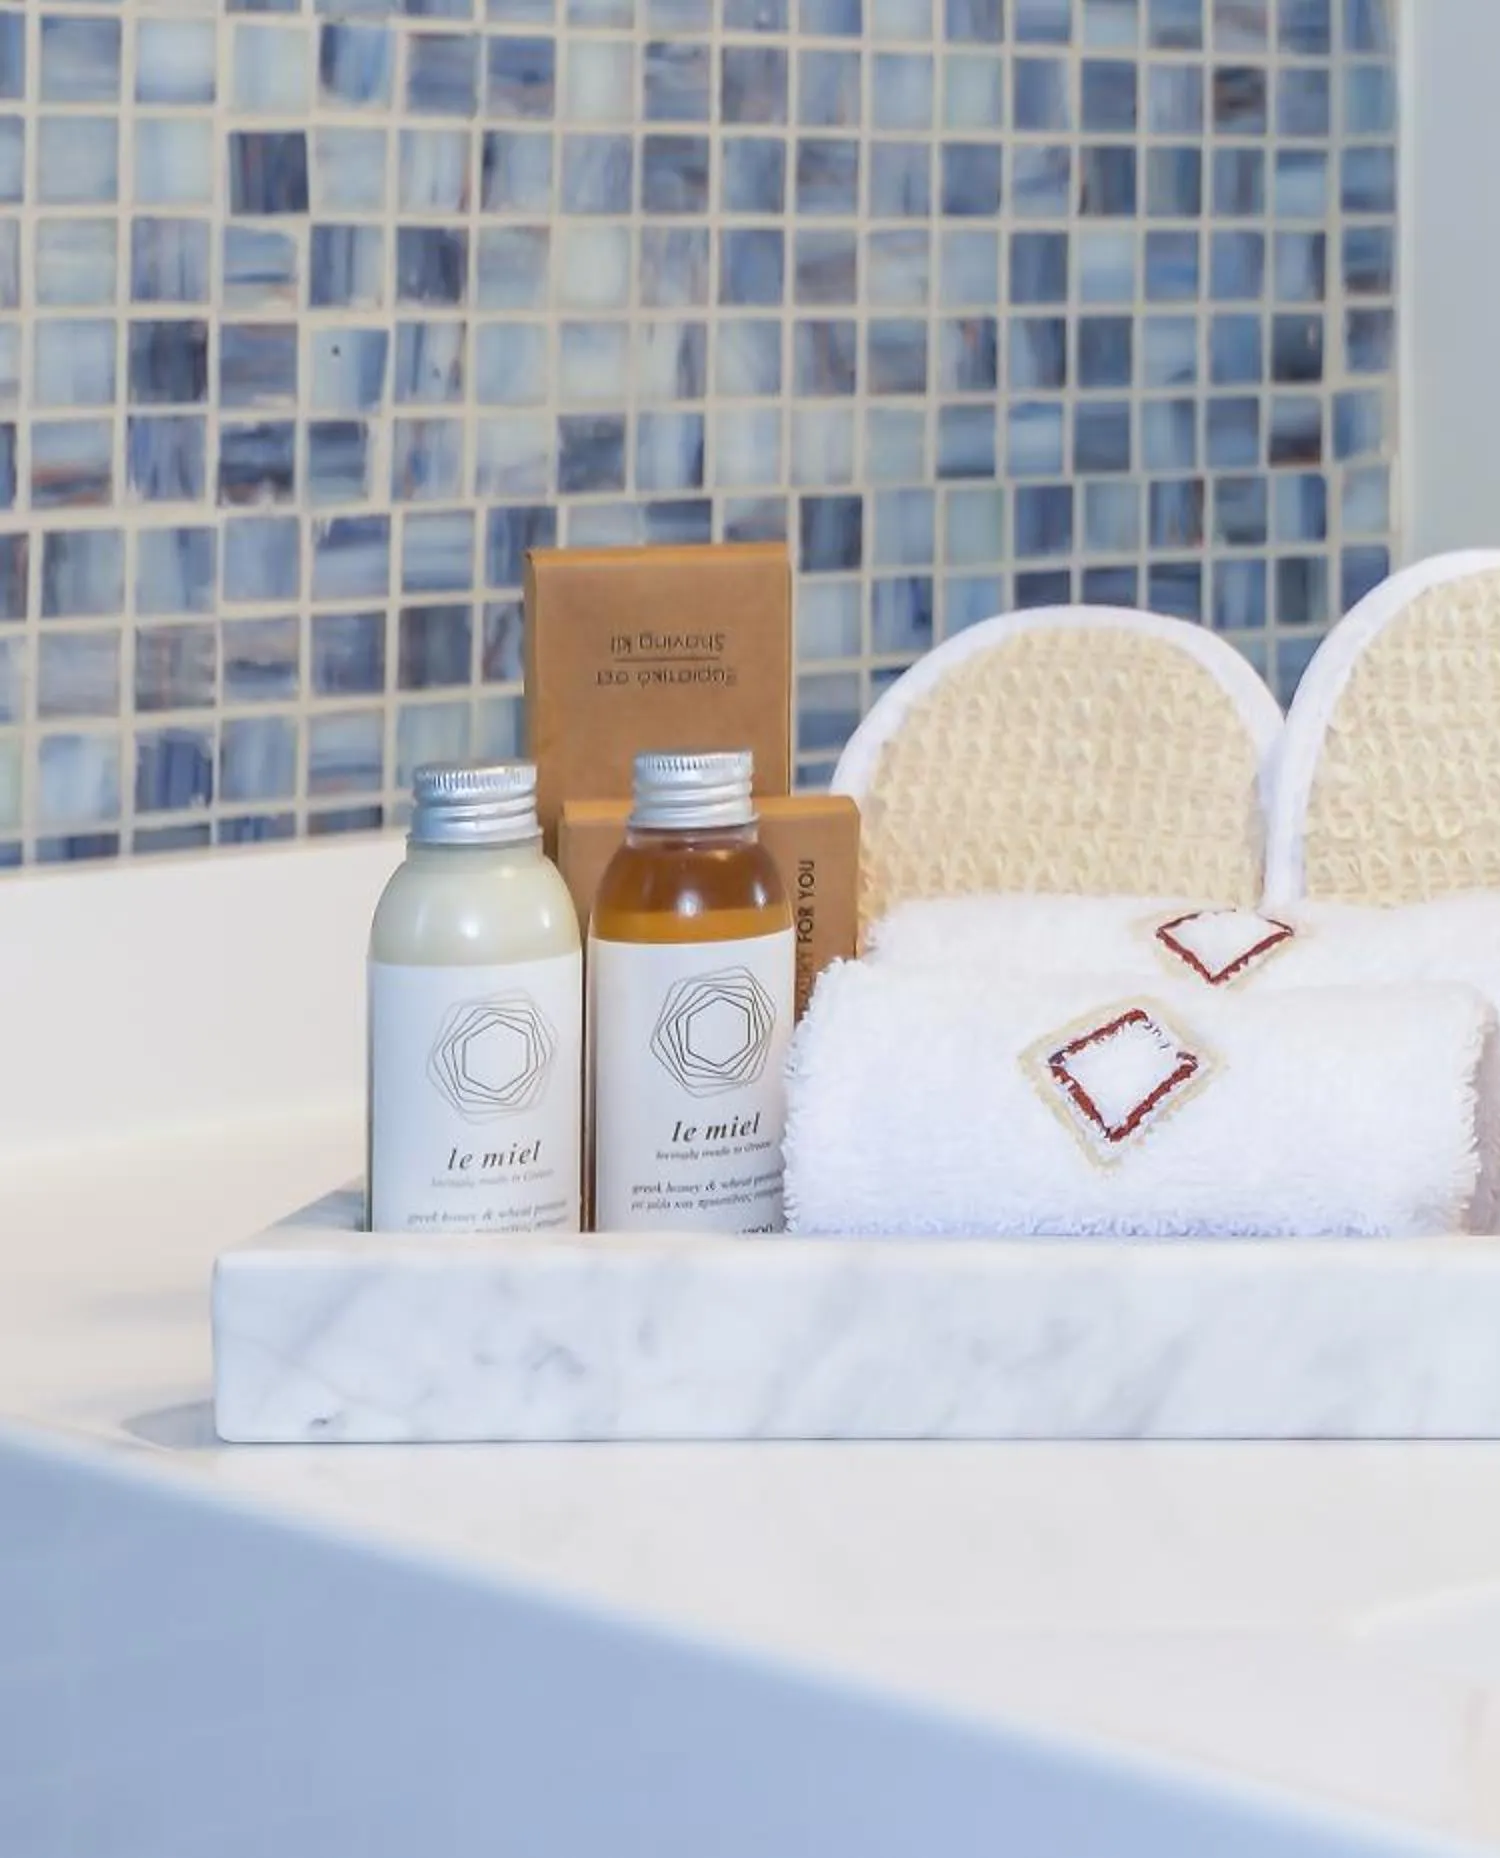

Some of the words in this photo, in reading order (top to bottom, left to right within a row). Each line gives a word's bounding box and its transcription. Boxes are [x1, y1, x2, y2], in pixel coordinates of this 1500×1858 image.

[610, 634, 631, 653] kit
[638, 631, 725, 651] Shaving
[797, 860, 815, 901] YOU
[797, 906, 814, 943] FOR
[671, 1120, 697, 1143] le
[705, 1111, 761, 1140] miel
[447, 1147, 473, 1171] le
[481, 1139, 541, 1169] miel
[666, 1180, 700, 1196] honey
[705, 1180, 717, 1192] &
